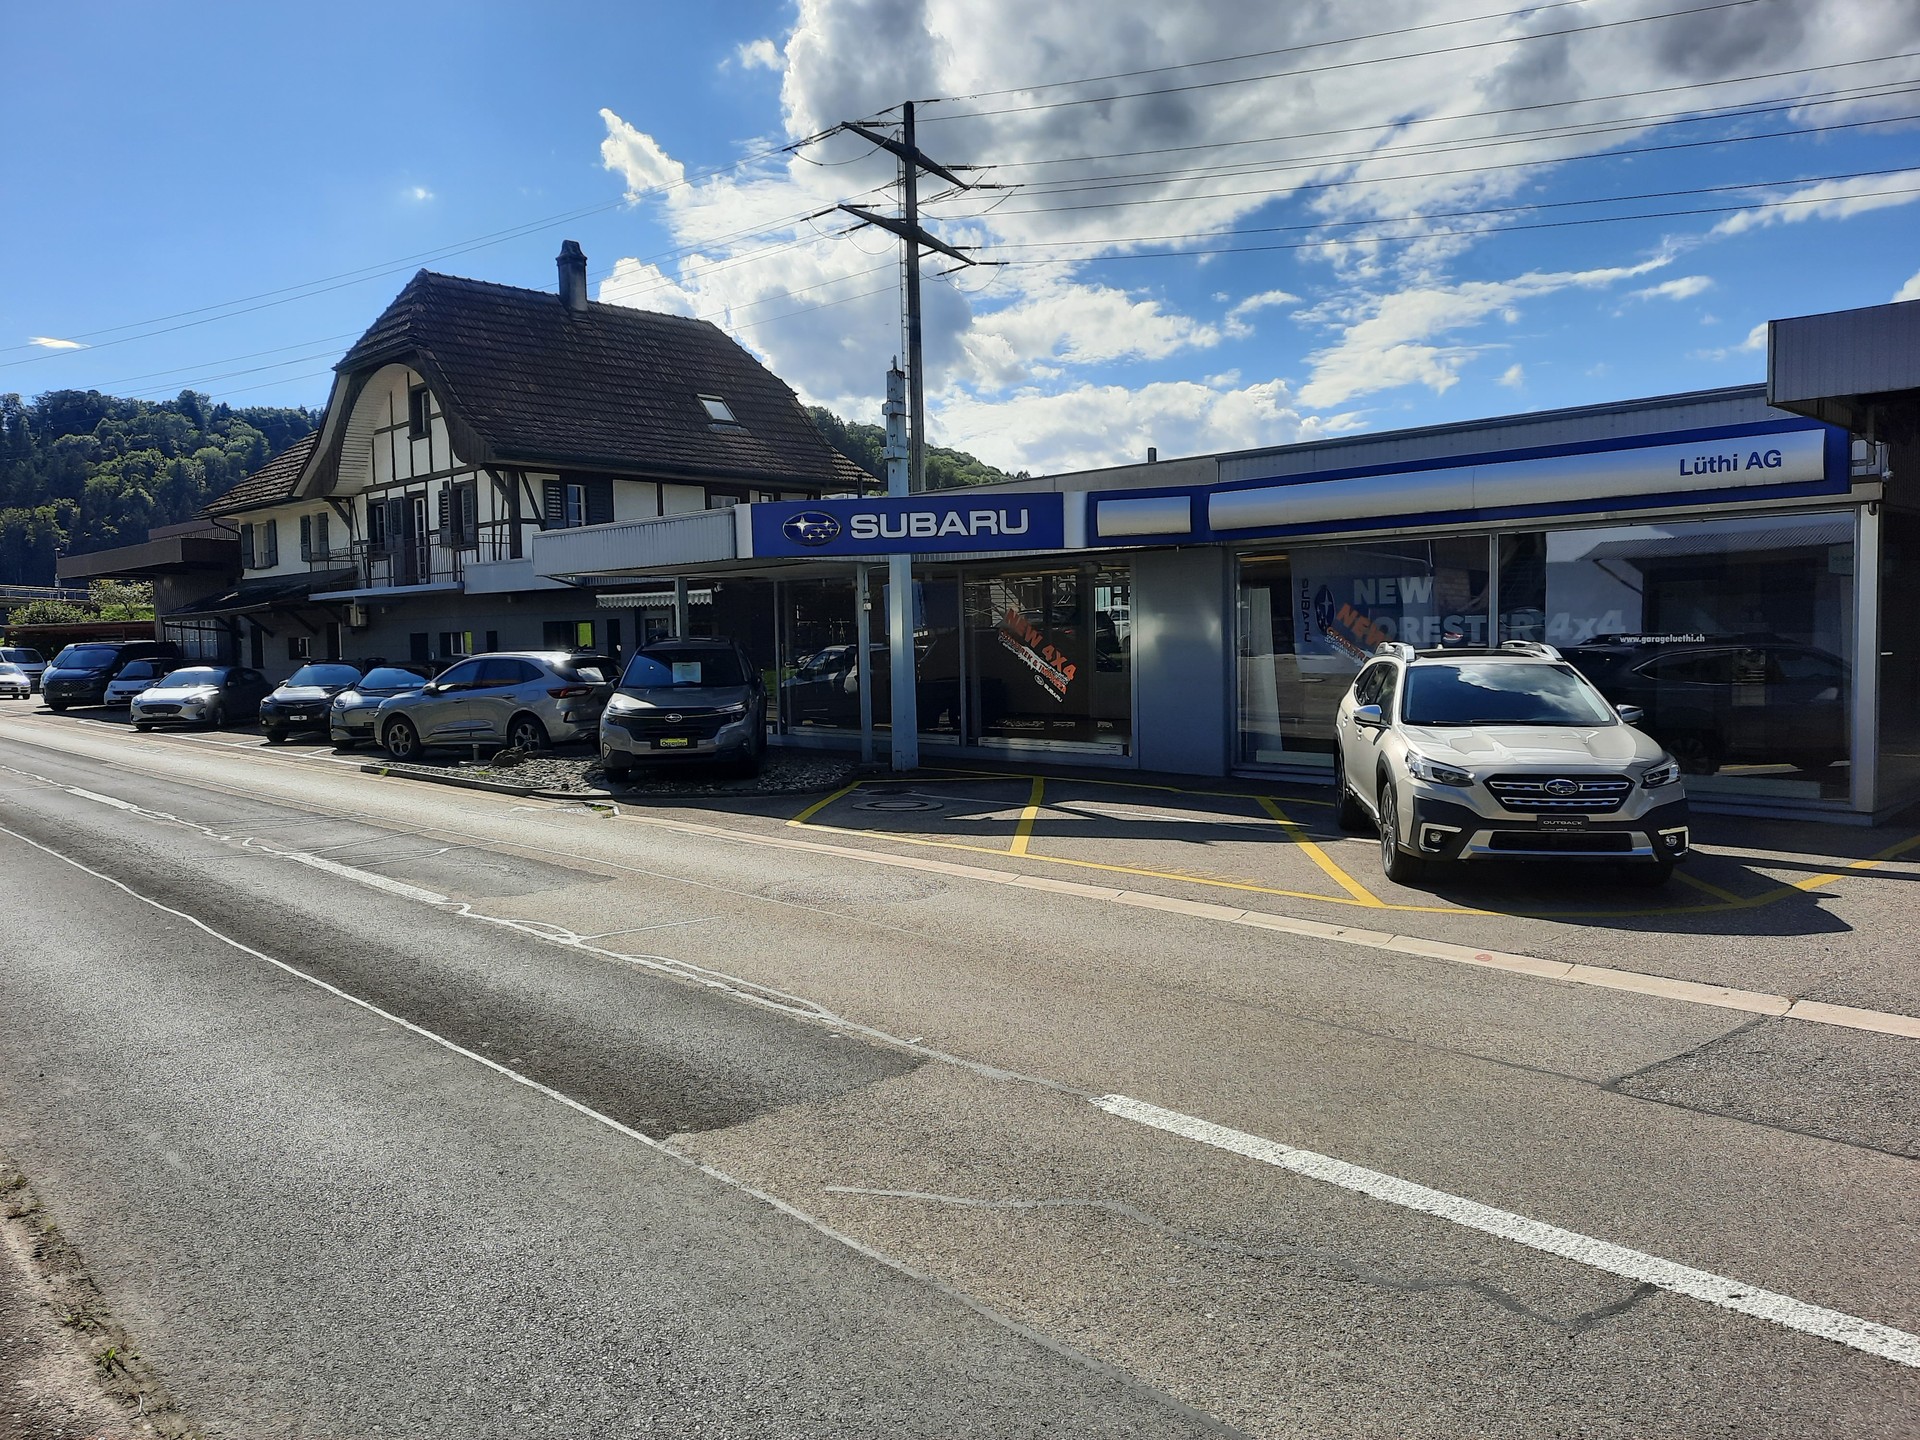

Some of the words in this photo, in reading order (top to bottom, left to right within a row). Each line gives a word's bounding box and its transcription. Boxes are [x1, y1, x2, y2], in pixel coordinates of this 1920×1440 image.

[1680, 453, 1738, 476] Lüthi
[1745, 449, 1782, 470] AG
[850, 508, 1029, 540] SUBARU
[1353, 576, 1433, 605] NEW
[1301, 578, 1312, 643] SUBARU
[1549, 609, 1626, 640] 4x4
[1005, 608, 1043, 648] NEW
[1042, 644, 1077, 681] 4X4
[1620, 633, 1706, 644] www.garageluethi.ch
